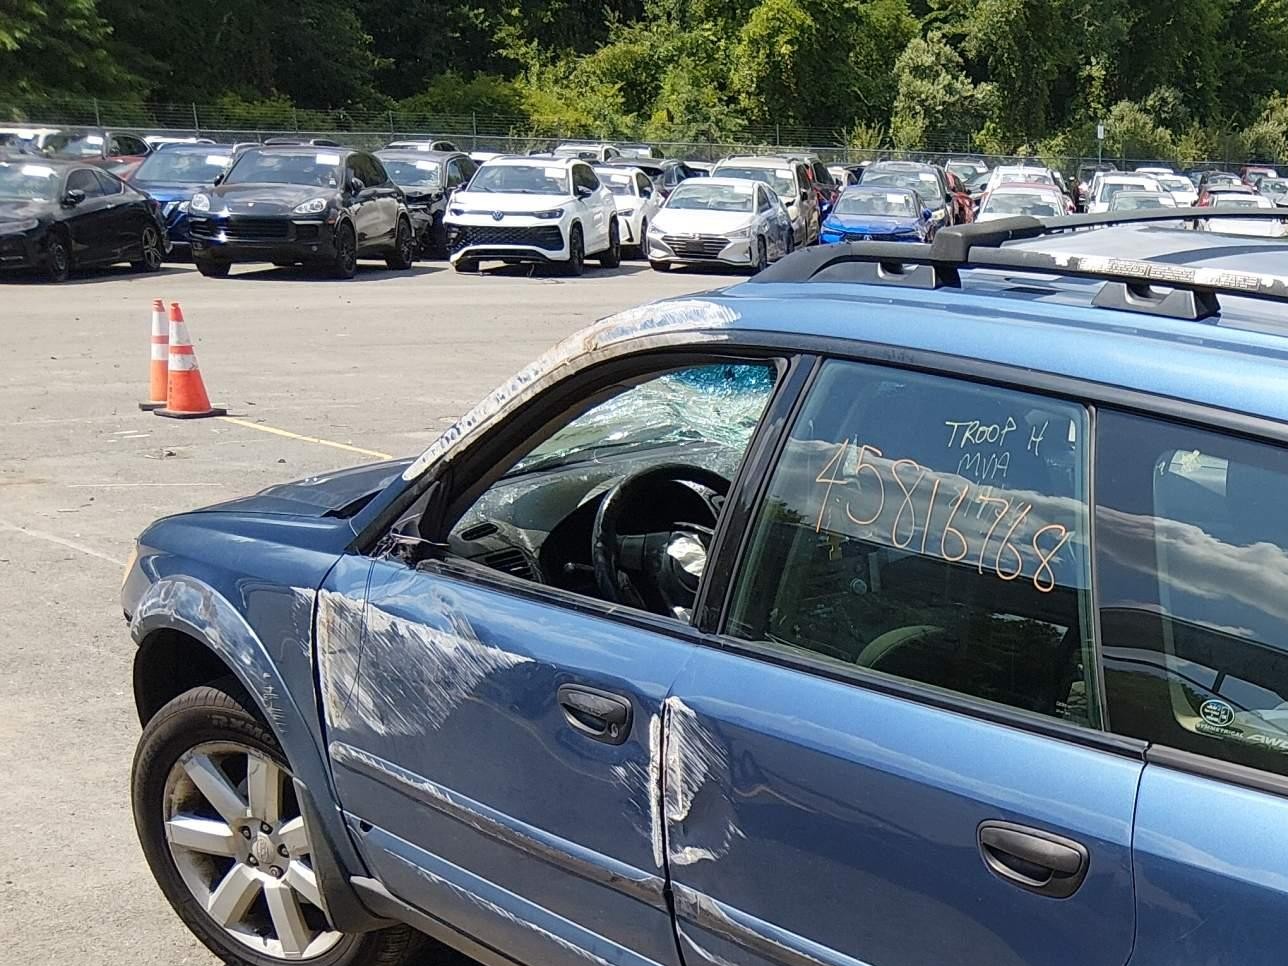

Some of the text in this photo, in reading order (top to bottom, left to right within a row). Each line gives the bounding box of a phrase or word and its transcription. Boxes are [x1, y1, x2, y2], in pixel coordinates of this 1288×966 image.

[945, 416, 1049, 456] TROOP H
[956, 451, 1011, 480] MVA
[815, 437, 1070, 594] 45816768
